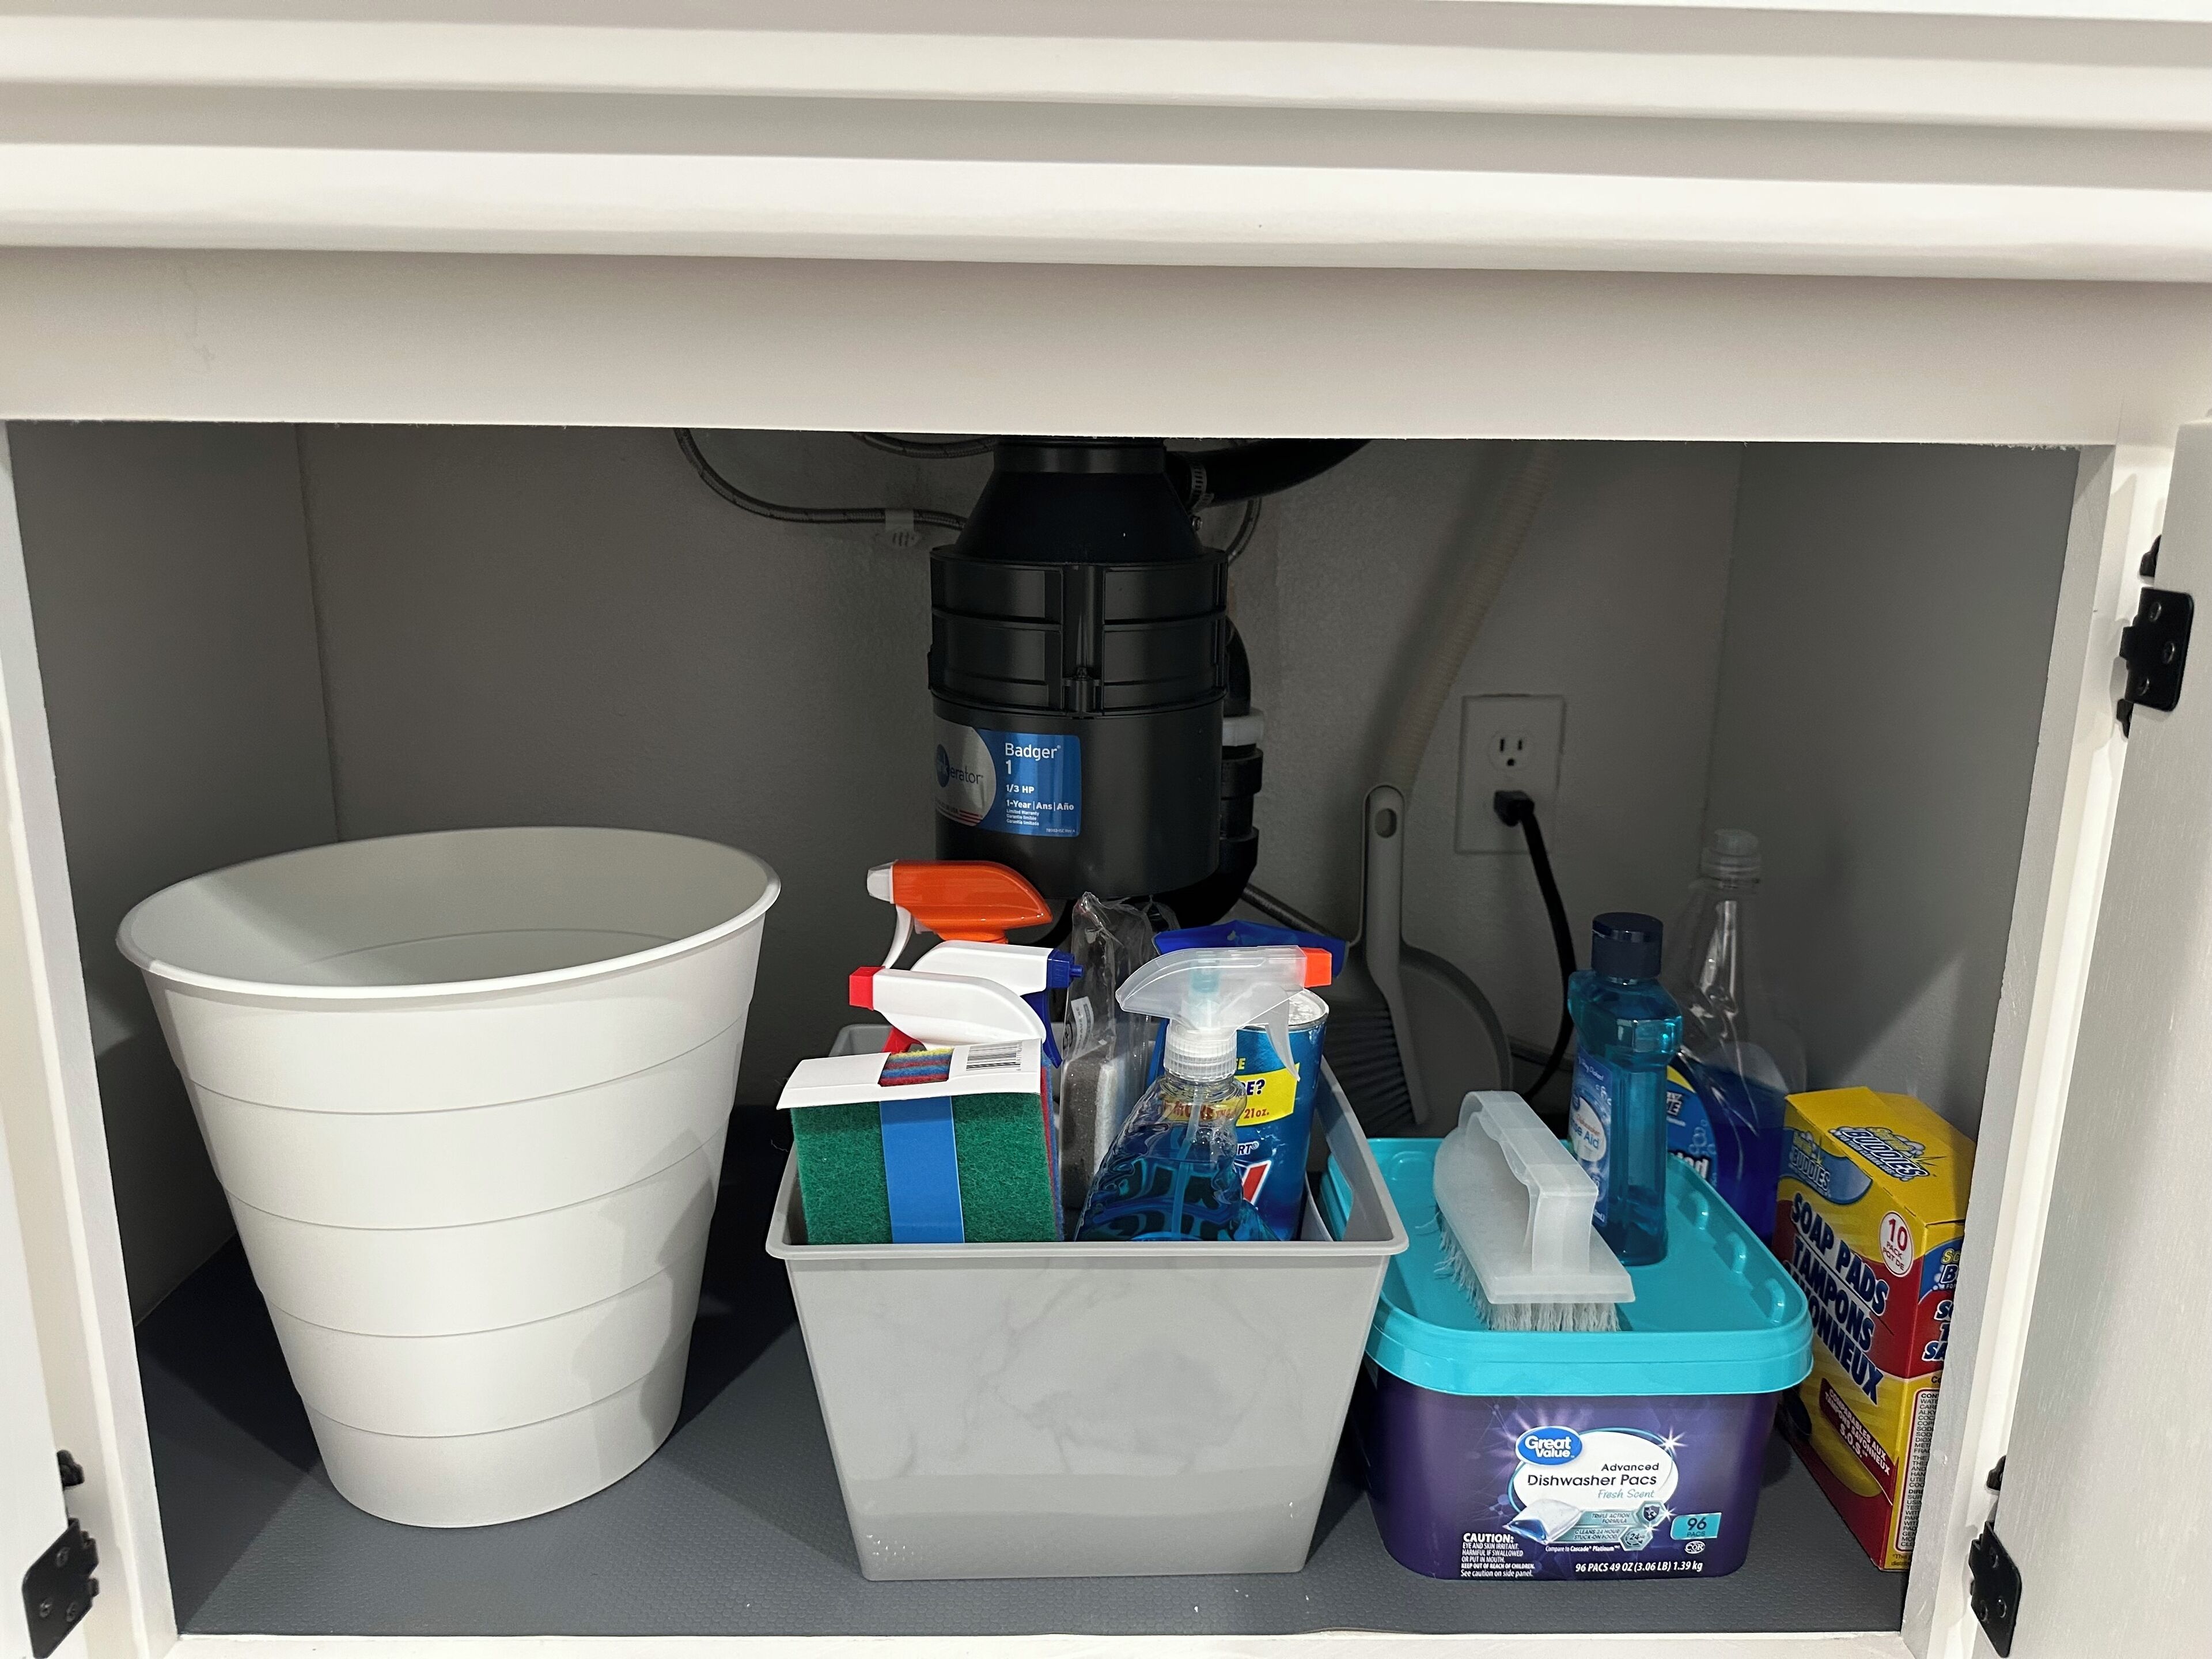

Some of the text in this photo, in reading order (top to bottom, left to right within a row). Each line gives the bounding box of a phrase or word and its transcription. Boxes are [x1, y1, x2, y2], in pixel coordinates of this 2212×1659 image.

[1005, 760, 1012, 774] 1
[1006, 784, 1020, 793] 1/3
[1584, 1131, 1599, 1150] Aid
[1842, 1130, 1928, 1176] BUDDIES
[1791, 1145, 1830, 1192] BUDDIES
[1889, 1218, 1908, 1251] 10
[1791, 1192, 1834, 1256] SOAP
[1836, 1240, 1889, 1316] PADS
[1887, 1241, 1903, 1260] PACK
[1896, 1259, 1904, 1271] DE
[1791, 1234, 1874, 1352] TAMPONS
[1829, 1389, 1887, 1461] COMPARABLES AUX
[1825, 1392, 1890, 1475] TAMPONS SAVONNEUX
[1524, 1435, 1572, 1450] Great
[1535, 1448, 1570, 1458] Value
[1601, 1463, 1660, 1471] Advanced
[1527, 1474, 1657, 1486] Dishwasher Pacs
[1597, 1488, 1655, 1499] Fresh Scent
[1687, 1517, 1707, 1530] 96
[1463, 1533, 1514, 1543] CAUTION:
[1575, 1560, 1703, 1573] 96 PACS 49 OZ (3.06 LB) 1.39 kg
[1515, 1570, 1533, 1578] panel.
